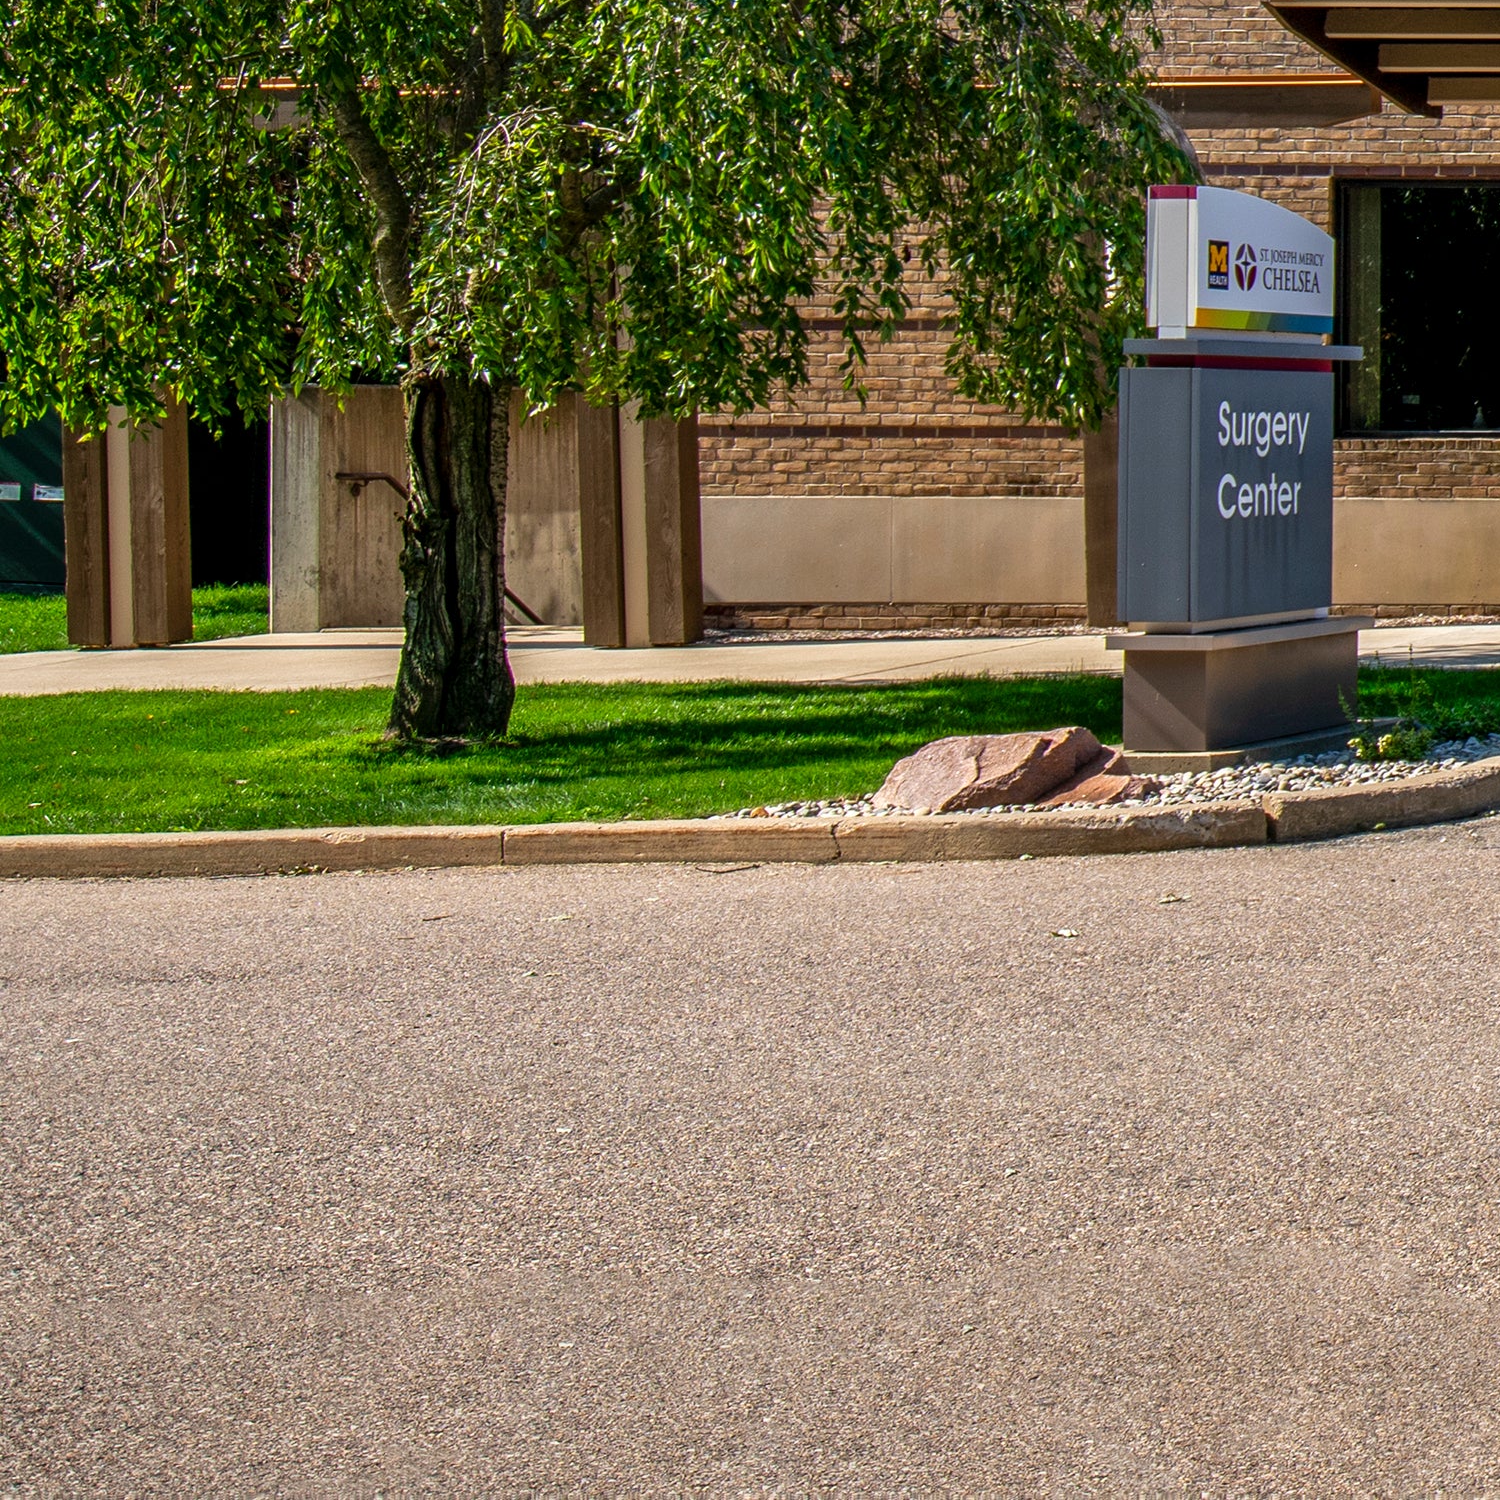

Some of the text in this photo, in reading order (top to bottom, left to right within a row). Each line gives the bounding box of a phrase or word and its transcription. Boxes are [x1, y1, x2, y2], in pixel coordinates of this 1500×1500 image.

[1209, 244, 1228, 273] M
[1270, 249, 1297, 265] JOSEPH
[1298, 252, 1325, 267] MERCY
[1209, 275, 1228, 286] HEALTH
[1262, 267, 1321, 293] CHELSEA
[1217, 400, 1310, 457] Surgery
[1217, 473, 1301, 519] Center
